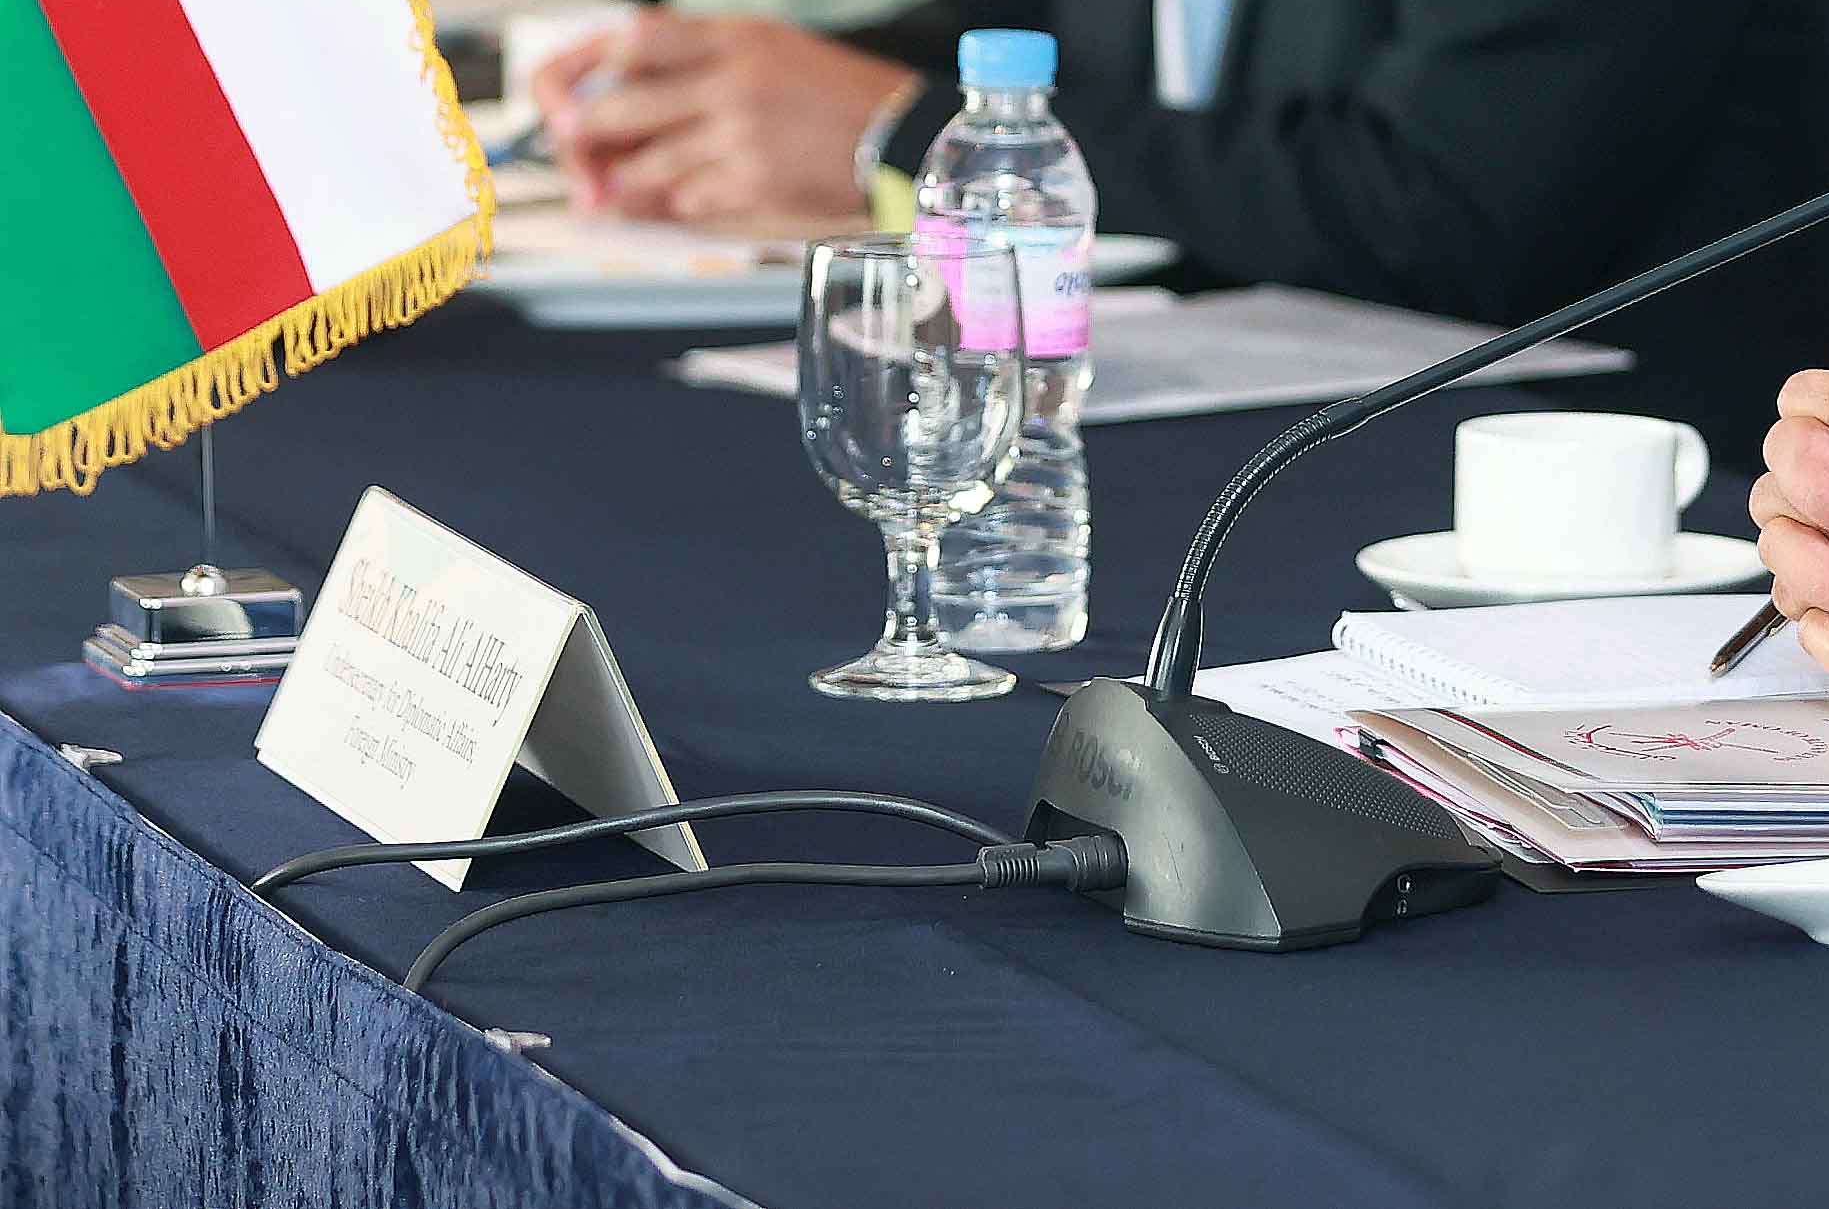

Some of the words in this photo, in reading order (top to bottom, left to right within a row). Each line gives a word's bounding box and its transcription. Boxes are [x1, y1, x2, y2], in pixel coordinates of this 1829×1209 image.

[338, 558, 398, 635] Sheikh
[382, 584, 447, 664] Khalifa
[432, 615, 475, 680] Ali
